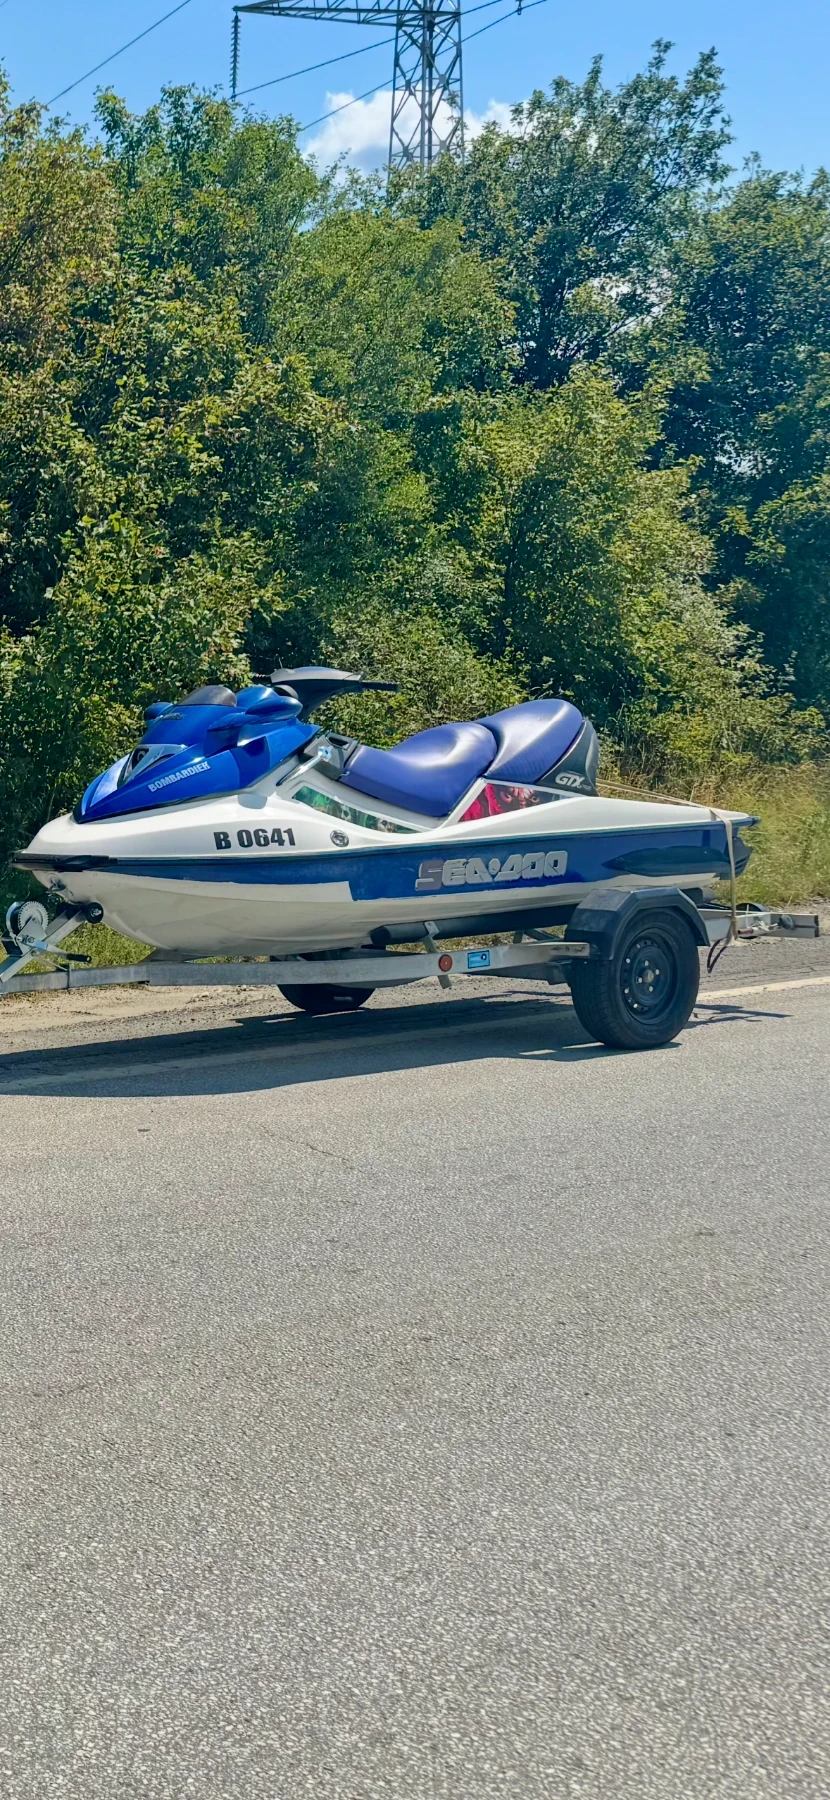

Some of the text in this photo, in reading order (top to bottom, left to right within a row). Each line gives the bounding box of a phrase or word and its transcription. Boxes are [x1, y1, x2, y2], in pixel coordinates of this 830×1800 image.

[148, 761, 211, 792] BOMBARDIER
[555, 772, 585, 788] GTX
[213, 828, 296, 850] B 0641
